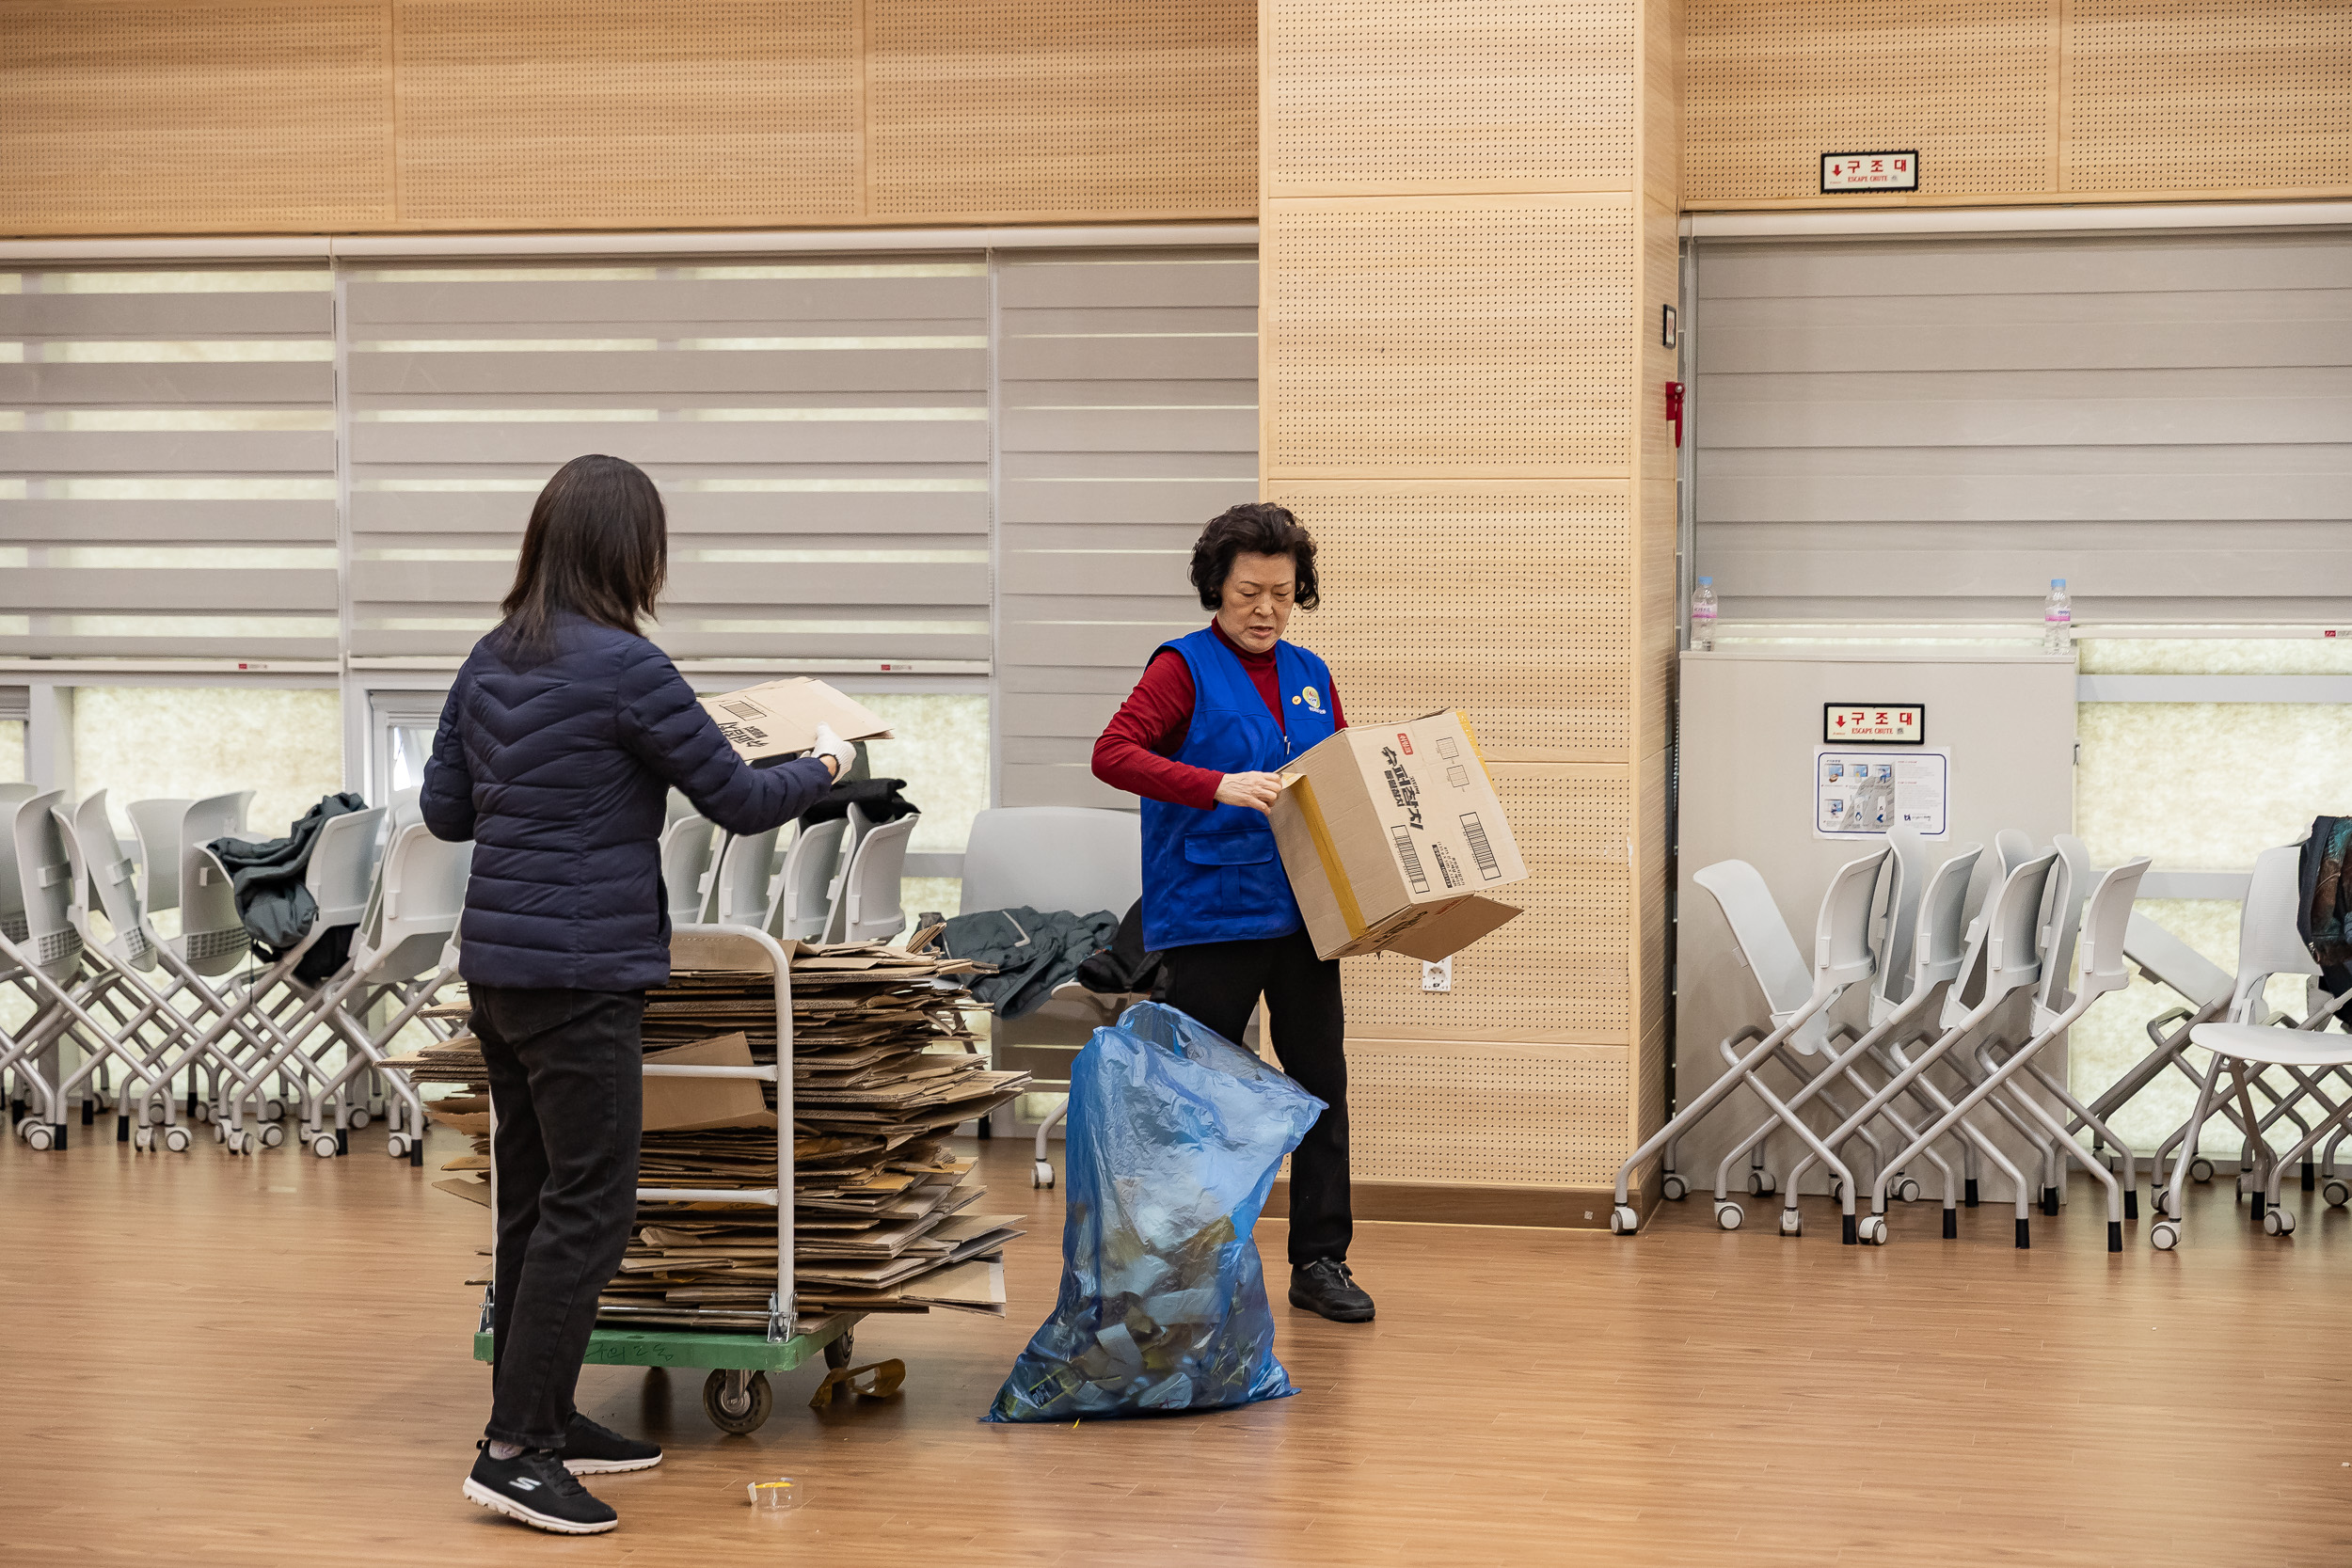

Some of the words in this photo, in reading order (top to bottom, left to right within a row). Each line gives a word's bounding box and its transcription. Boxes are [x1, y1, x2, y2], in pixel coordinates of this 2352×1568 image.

[1847, 159, 1907, 174] 구조대
[1851, 712, 1913, 725] 구조대
[1381, 746, 1424, 831] 슈퍼참치
